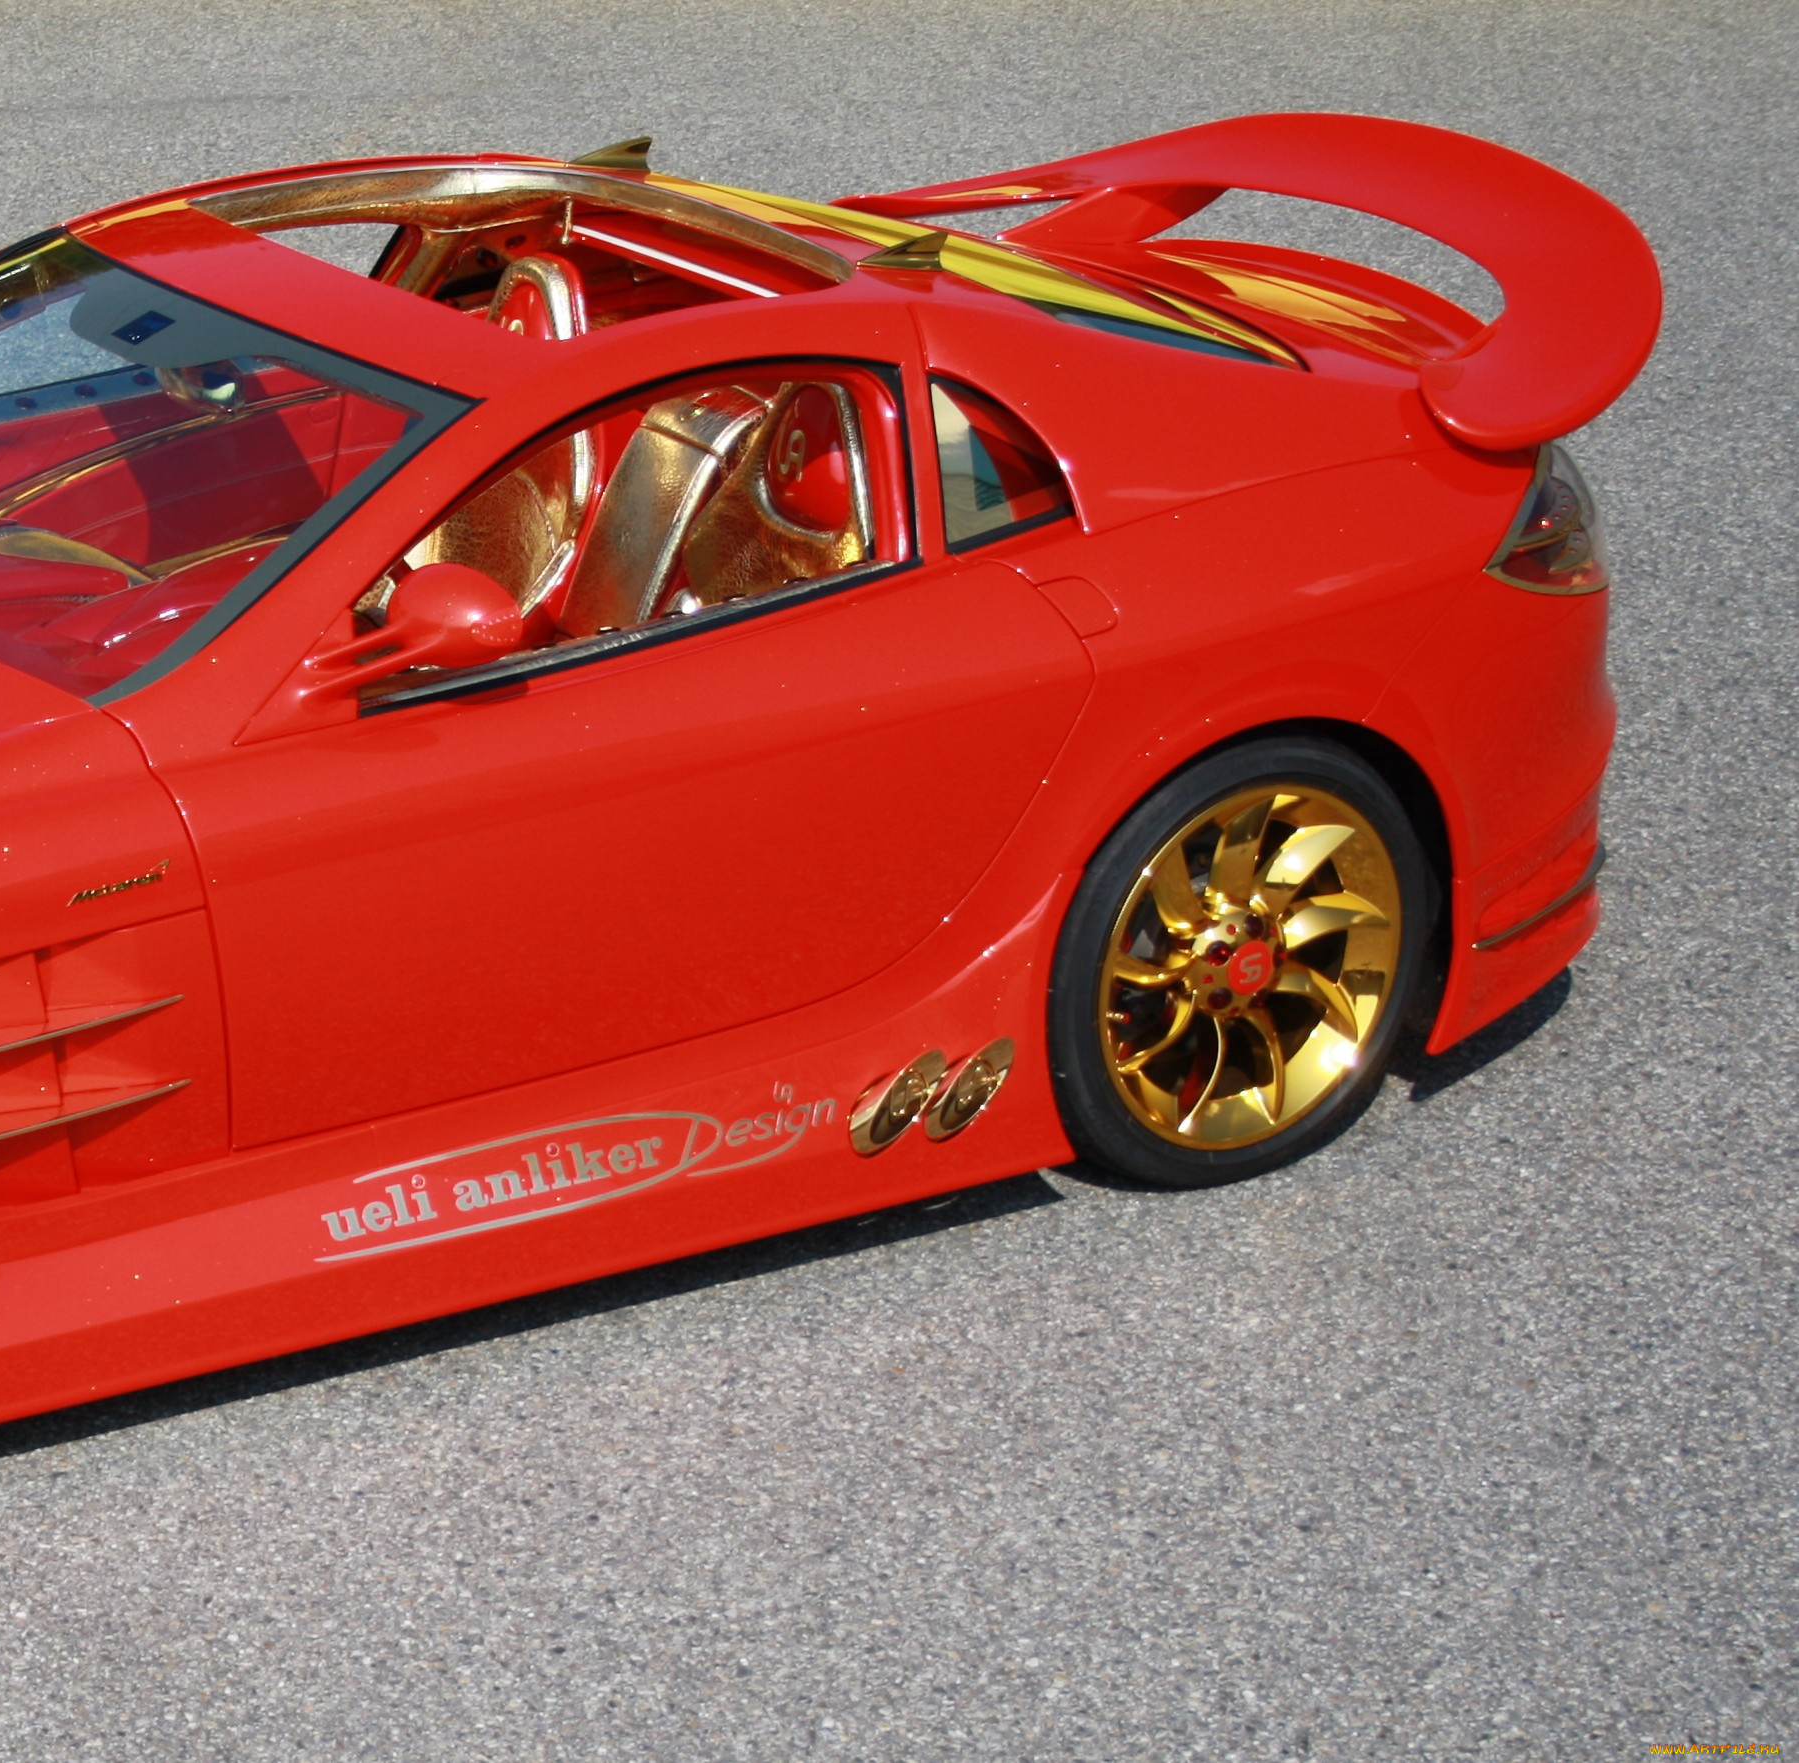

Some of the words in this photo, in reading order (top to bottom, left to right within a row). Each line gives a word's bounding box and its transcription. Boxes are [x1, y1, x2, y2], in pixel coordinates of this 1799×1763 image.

[321, 1174, 437, 1242] ueli
[453, 1136, 662, 1212] anliker
[679, 1098, 836, 1176] Design
